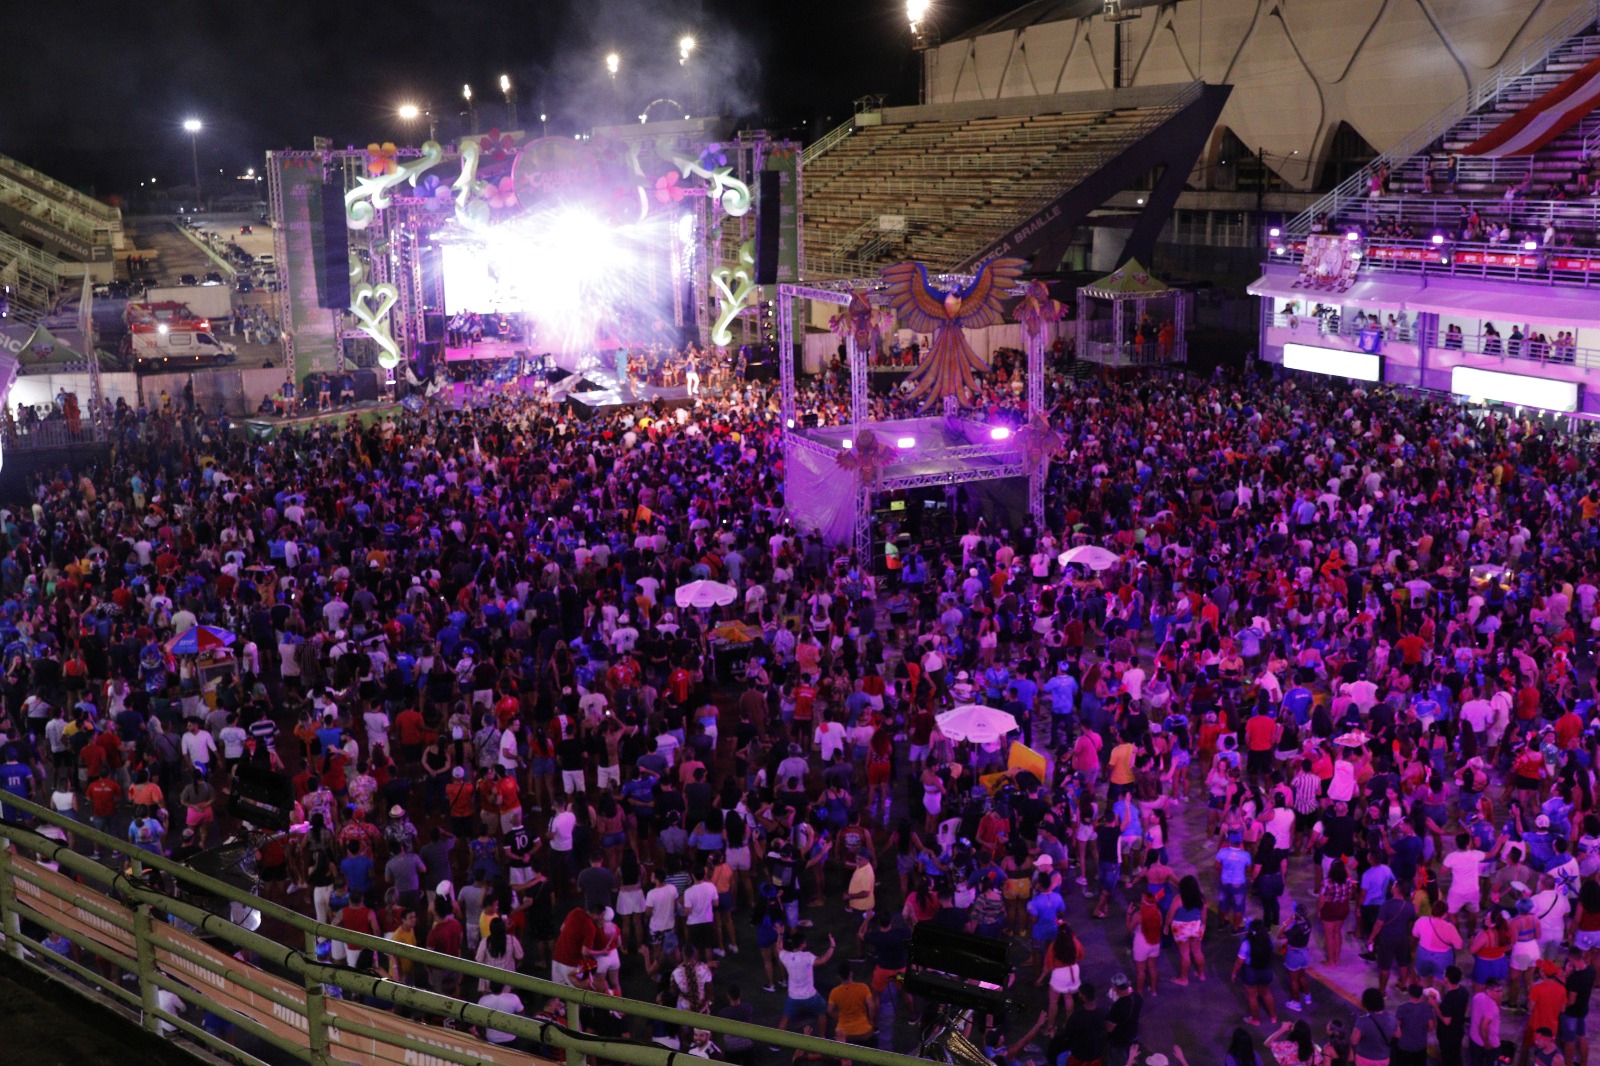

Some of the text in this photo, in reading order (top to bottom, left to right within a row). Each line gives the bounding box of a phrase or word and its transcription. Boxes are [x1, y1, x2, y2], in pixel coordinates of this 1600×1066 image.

[965, 205, 1062, 275] IOTECA BRAILLE
[91, 246, 106, 260] F
[515, 834, 528, 850] 10
